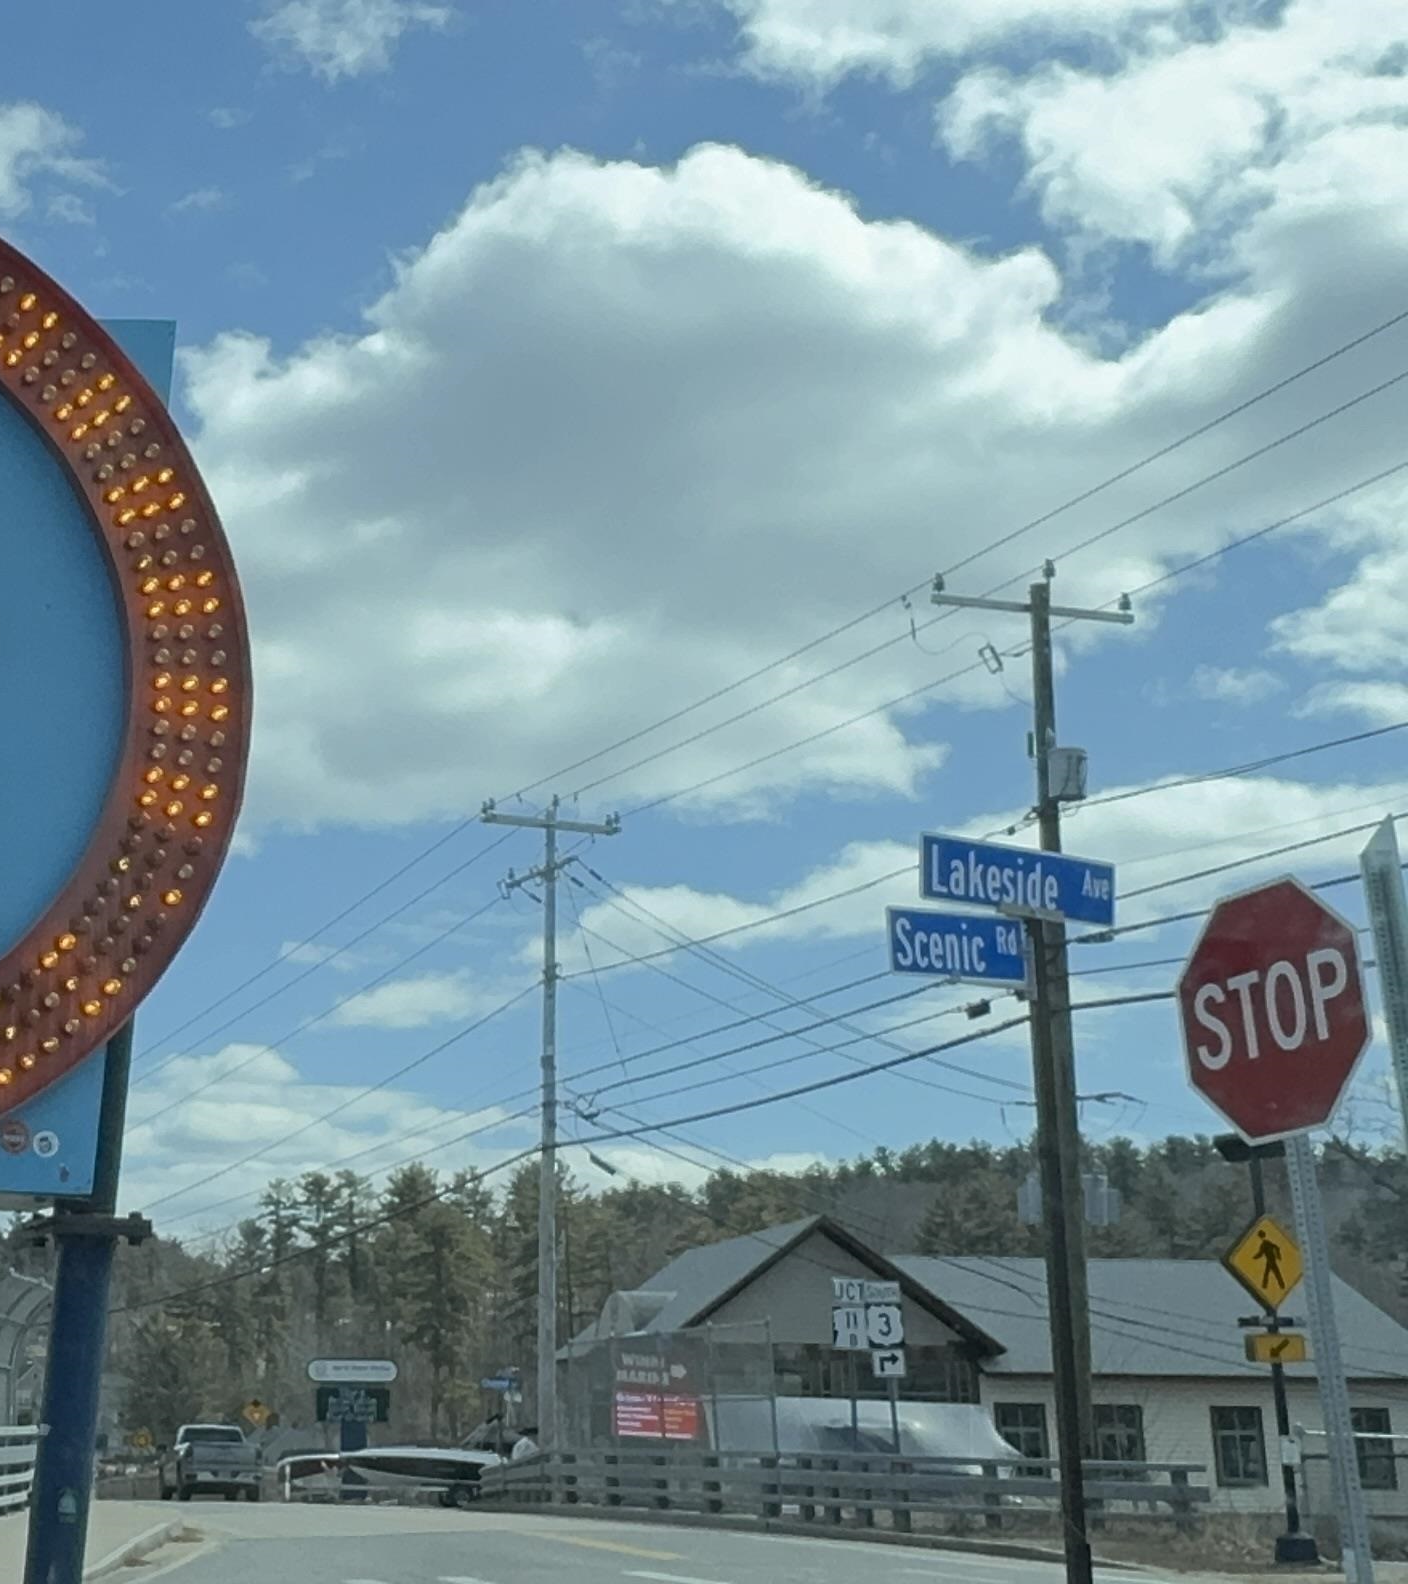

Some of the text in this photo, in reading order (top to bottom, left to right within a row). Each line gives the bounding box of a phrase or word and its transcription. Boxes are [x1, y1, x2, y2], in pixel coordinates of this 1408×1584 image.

[931, 843, 1110, 910] Lakeside Ave
[895, 917, 1018, 973] Scenic Rd
[1194, 947, 1348, 1071] STOP
[835, 1282, 865, 1300] JCT
[845, 1311, 858, 1330] 11
[878, 1312, 892, 1337] 3
